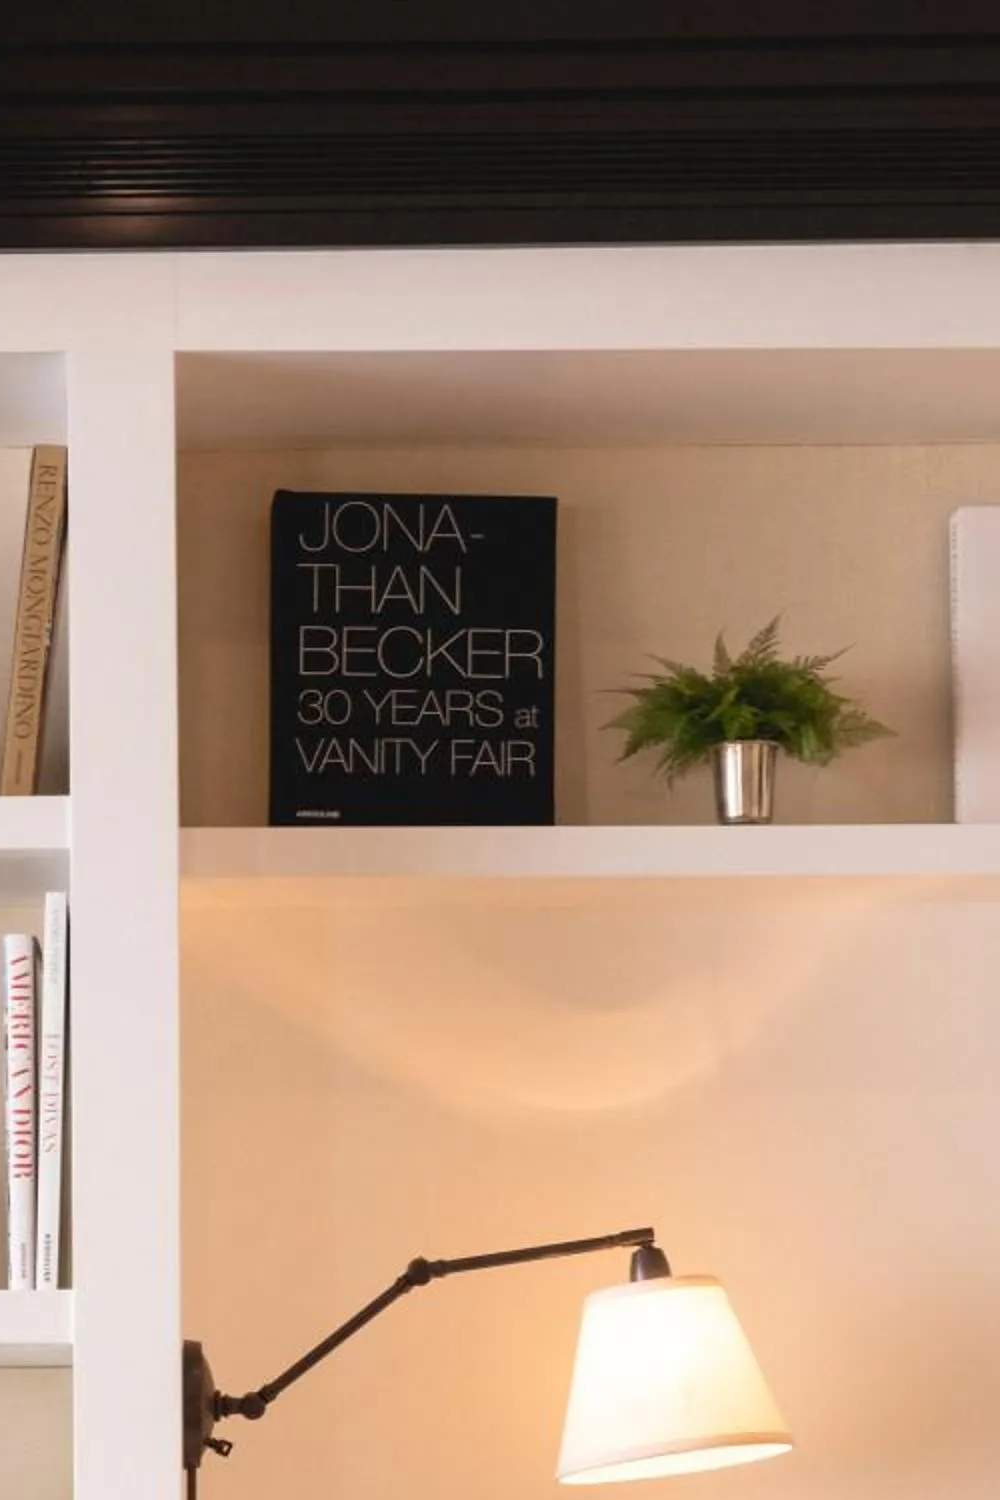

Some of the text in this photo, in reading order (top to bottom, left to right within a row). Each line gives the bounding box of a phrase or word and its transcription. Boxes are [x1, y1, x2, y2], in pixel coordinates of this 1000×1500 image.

[298, 500, 485, 553] JONA-
[13, 464, 58, 740] RENZO MONGIARDINO
[296, 563, 462, 616] THAN
[299, 624, 544, 680] BECKER
[297, 688, 540, 730] 30 YEARS at
[295, 737, 537, 777] VANITY FAIR
[13, 1109, 33, 1179] DIOR
